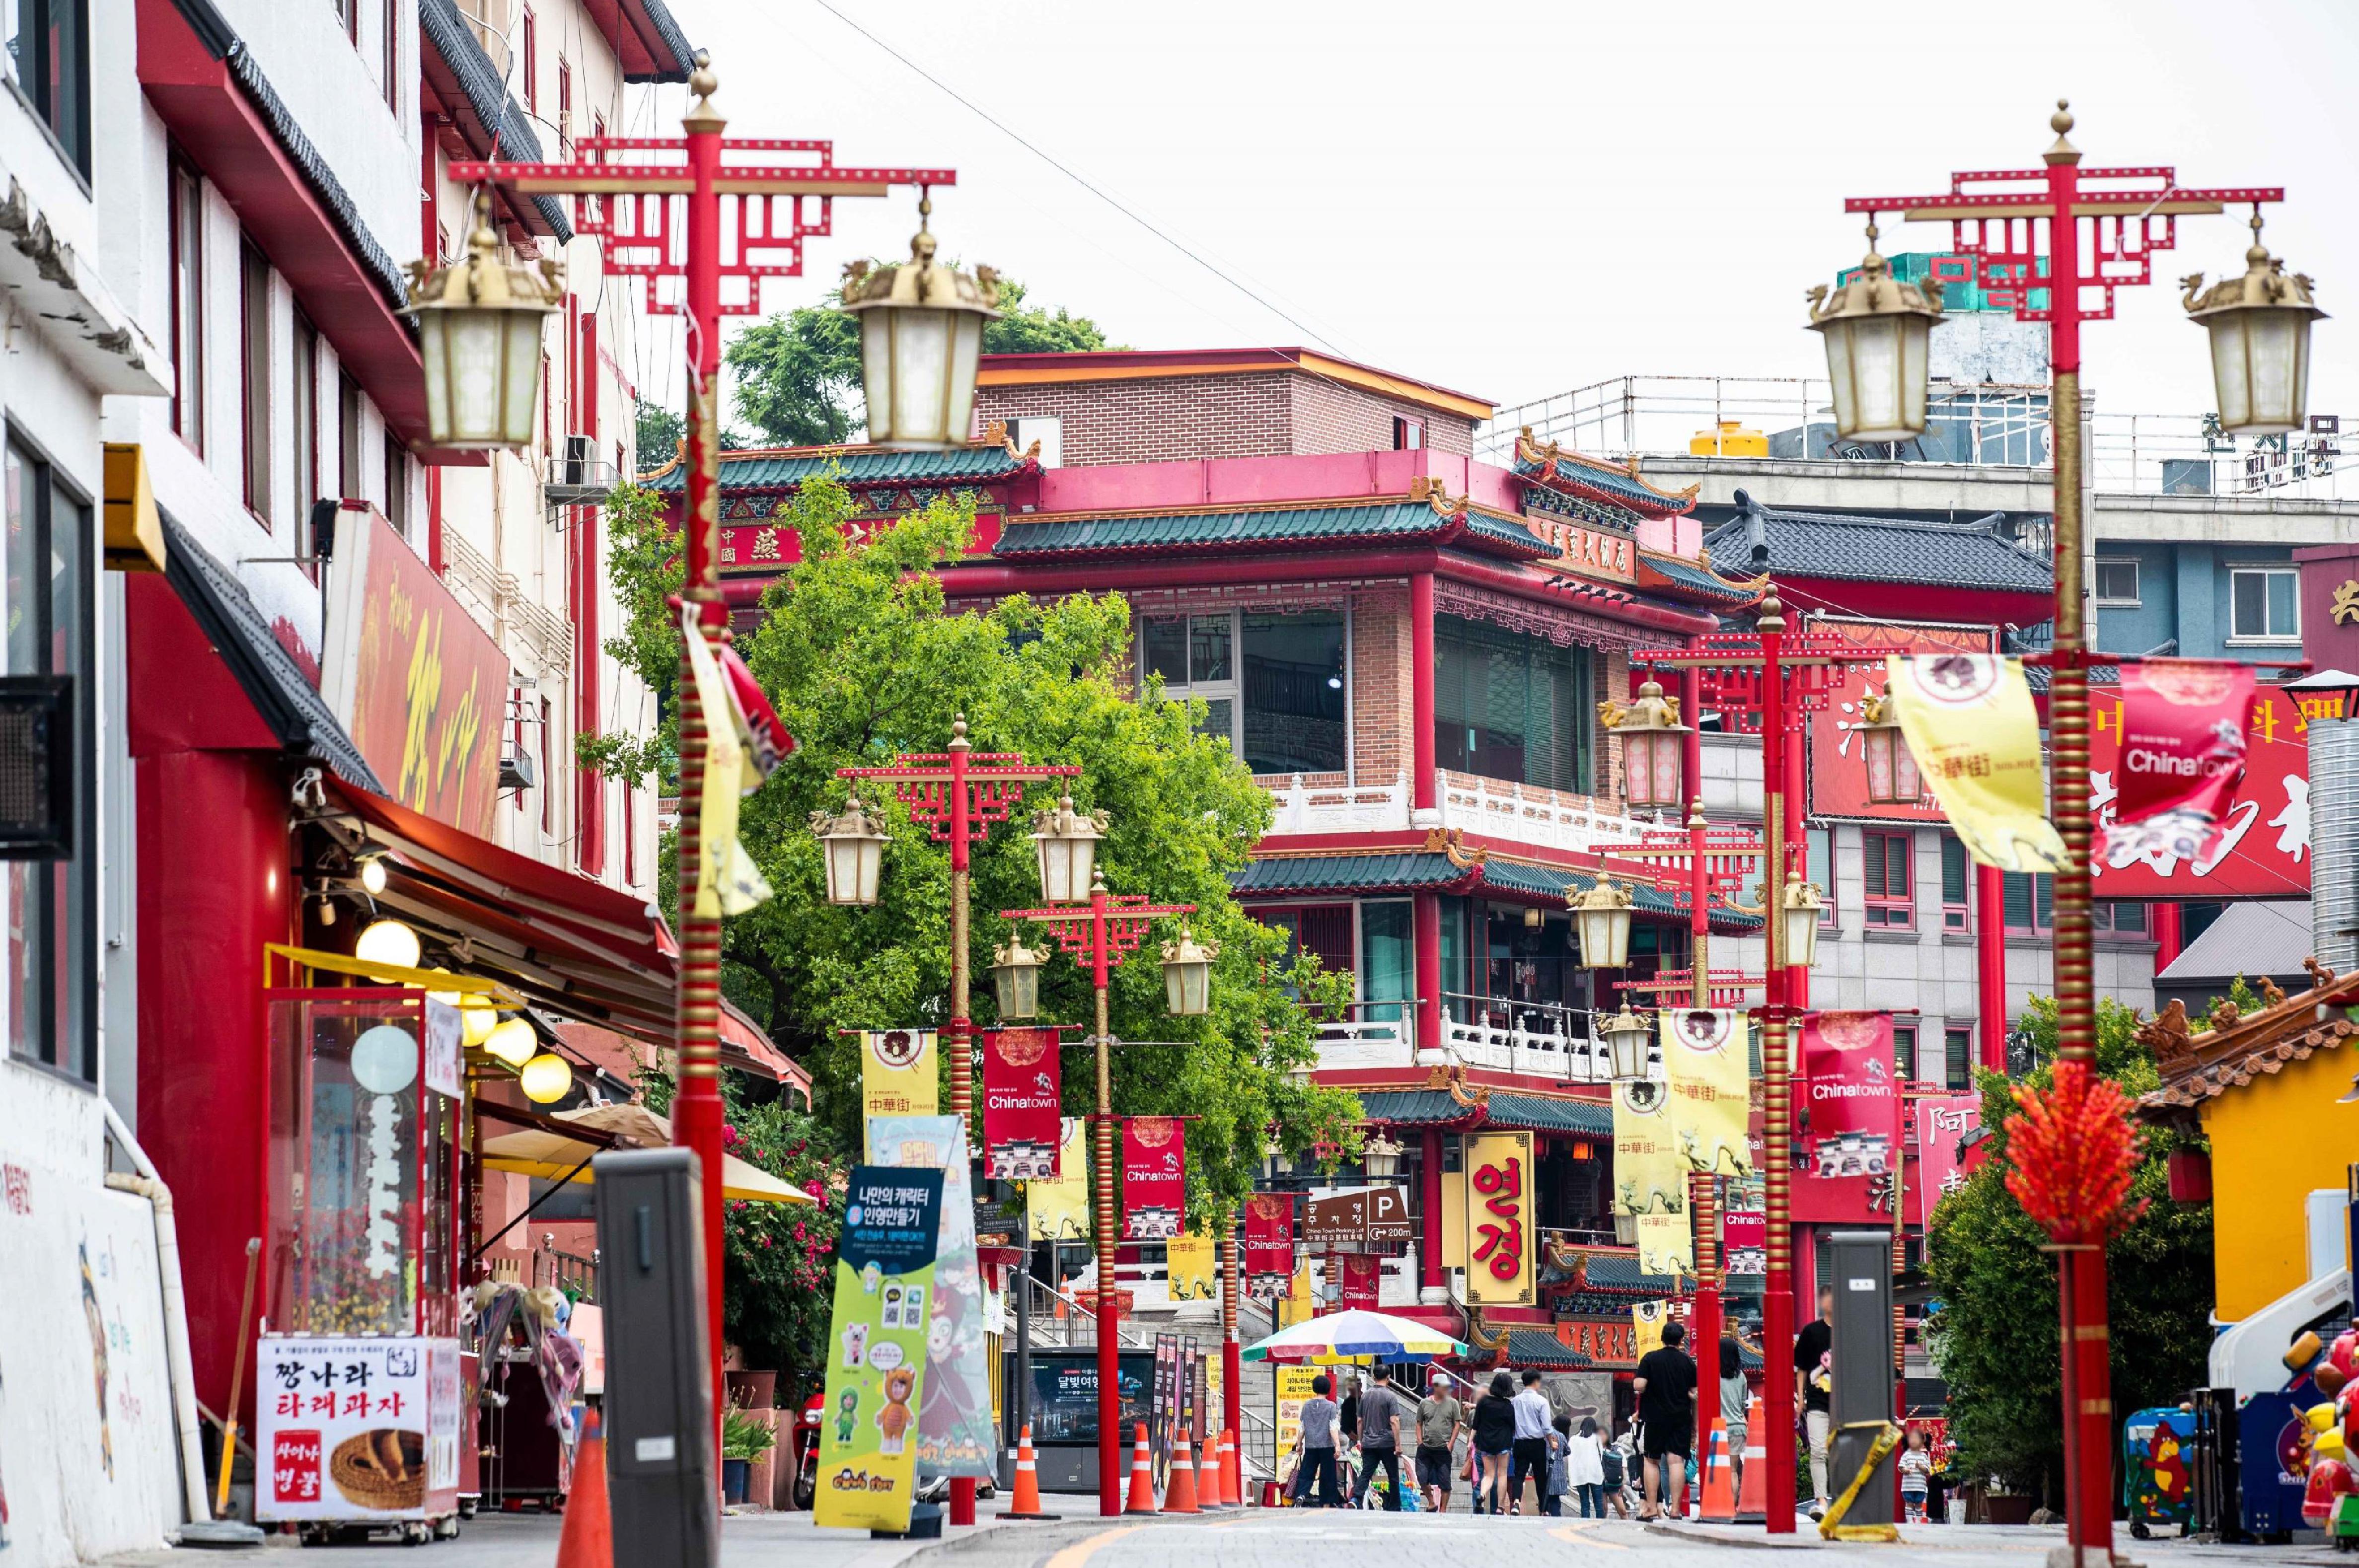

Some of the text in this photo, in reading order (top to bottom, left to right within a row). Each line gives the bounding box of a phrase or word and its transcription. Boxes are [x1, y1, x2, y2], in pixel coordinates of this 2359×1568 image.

[722, 529, 735, 563] 中國
[2127, 749, 2236, 778] Chinatow
[1674, 1084, 1716, 1102] 中華街
[1813, 1084, 1891, 1099] Chinatown
[869, 1098, 910, 1112] 中華街
[989, 1095, 1057, 1109] Chinatown
[1619, 1141, 1655, 1154] 中華街
[1127, 1171, 1181, 1182] Chinatown
[859, 1186, 930, 1207] 나만의 캐릭터
[1379, 1197, 1393, 1218] P
[864, 1207, 921, 1227] 인형만들기
[1473, 1157, 1522, 1280] 연경
[1641, 1216, 1670, 1227] 中華街
[1727, 1214, 1766, 1225] Chinatow
[1388, 1228, 1411, 1237] 200m
[1171, 1242, 1196, 1253] 中華街
[1249, 1240, 1290, 1250] Chinatown
[1344, 1291, 1378, 1300] Chinatown
[275, 1361, 373, 1389] 짱나라
[276, 1391, 406, 1419] 타래과자
